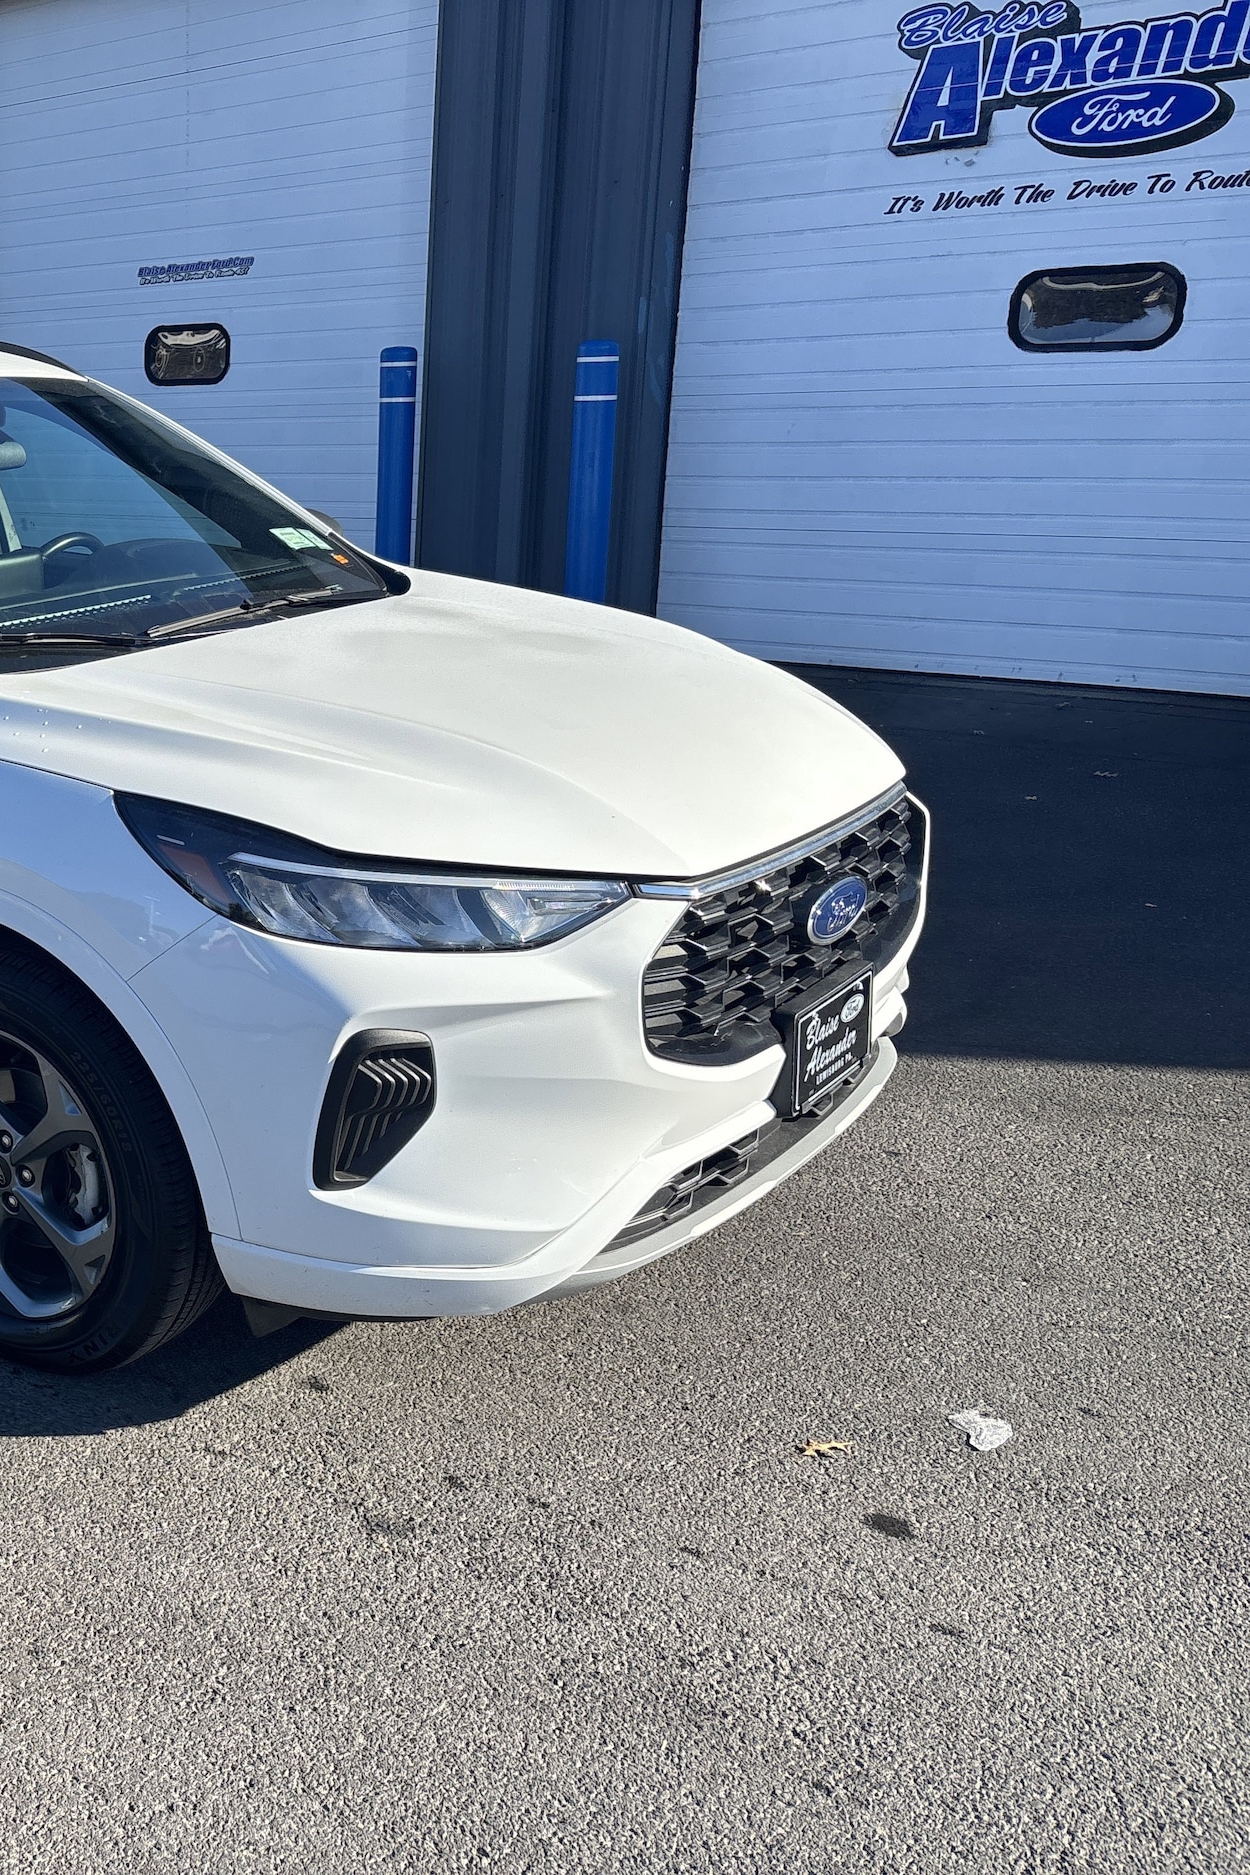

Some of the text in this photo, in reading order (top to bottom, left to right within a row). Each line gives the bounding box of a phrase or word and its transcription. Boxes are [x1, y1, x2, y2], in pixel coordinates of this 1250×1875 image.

[901, 3, 1067, 49] Blaise
[893, 0, 1250, 146] Alexand
[1071, 91, 1175, 136] Ford
[884, 195, 924, 215] It's
[932, 186, 1005, 211] Worth
[1014, 184, 1055, 206] The
[1066, 178, 1138, 202] Drive
[1147, 173, 1176, 194] To
[805, 1014, 840, 1050] Blaise
[804, 1028, 857, 1082] Alexander
